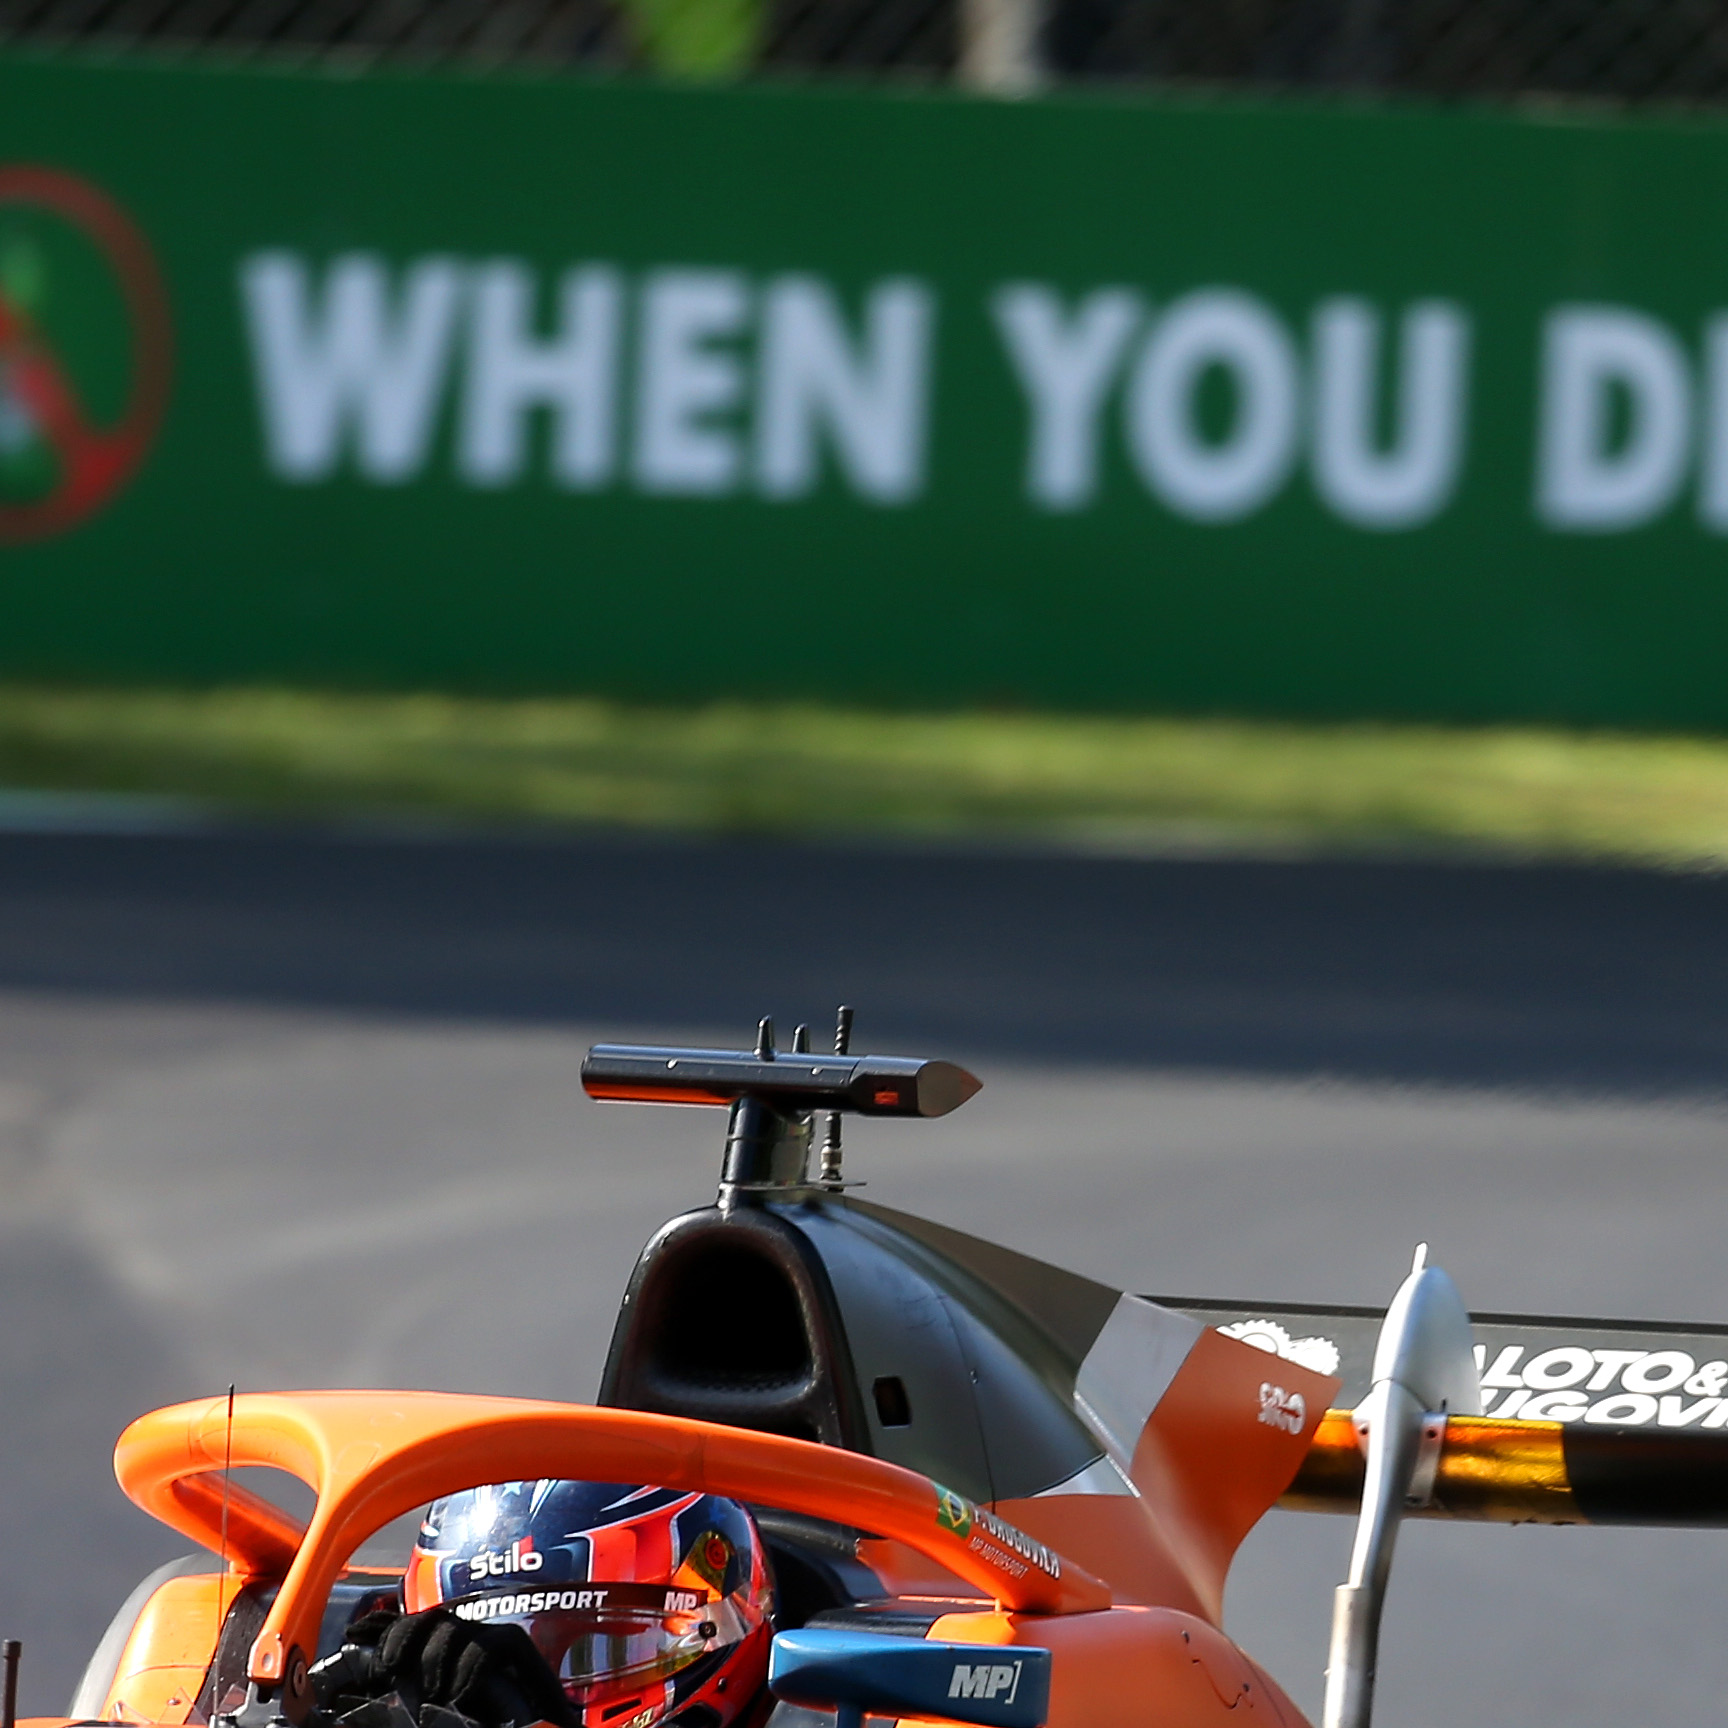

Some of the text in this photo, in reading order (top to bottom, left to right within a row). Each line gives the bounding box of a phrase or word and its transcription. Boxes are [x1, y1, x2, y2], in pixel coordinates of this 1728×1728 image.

[245, 255, 930, 499] WHEN
[997, 286, 1466, 525] YOU
[1473, 1344, 1728, 1397] LOTO&
